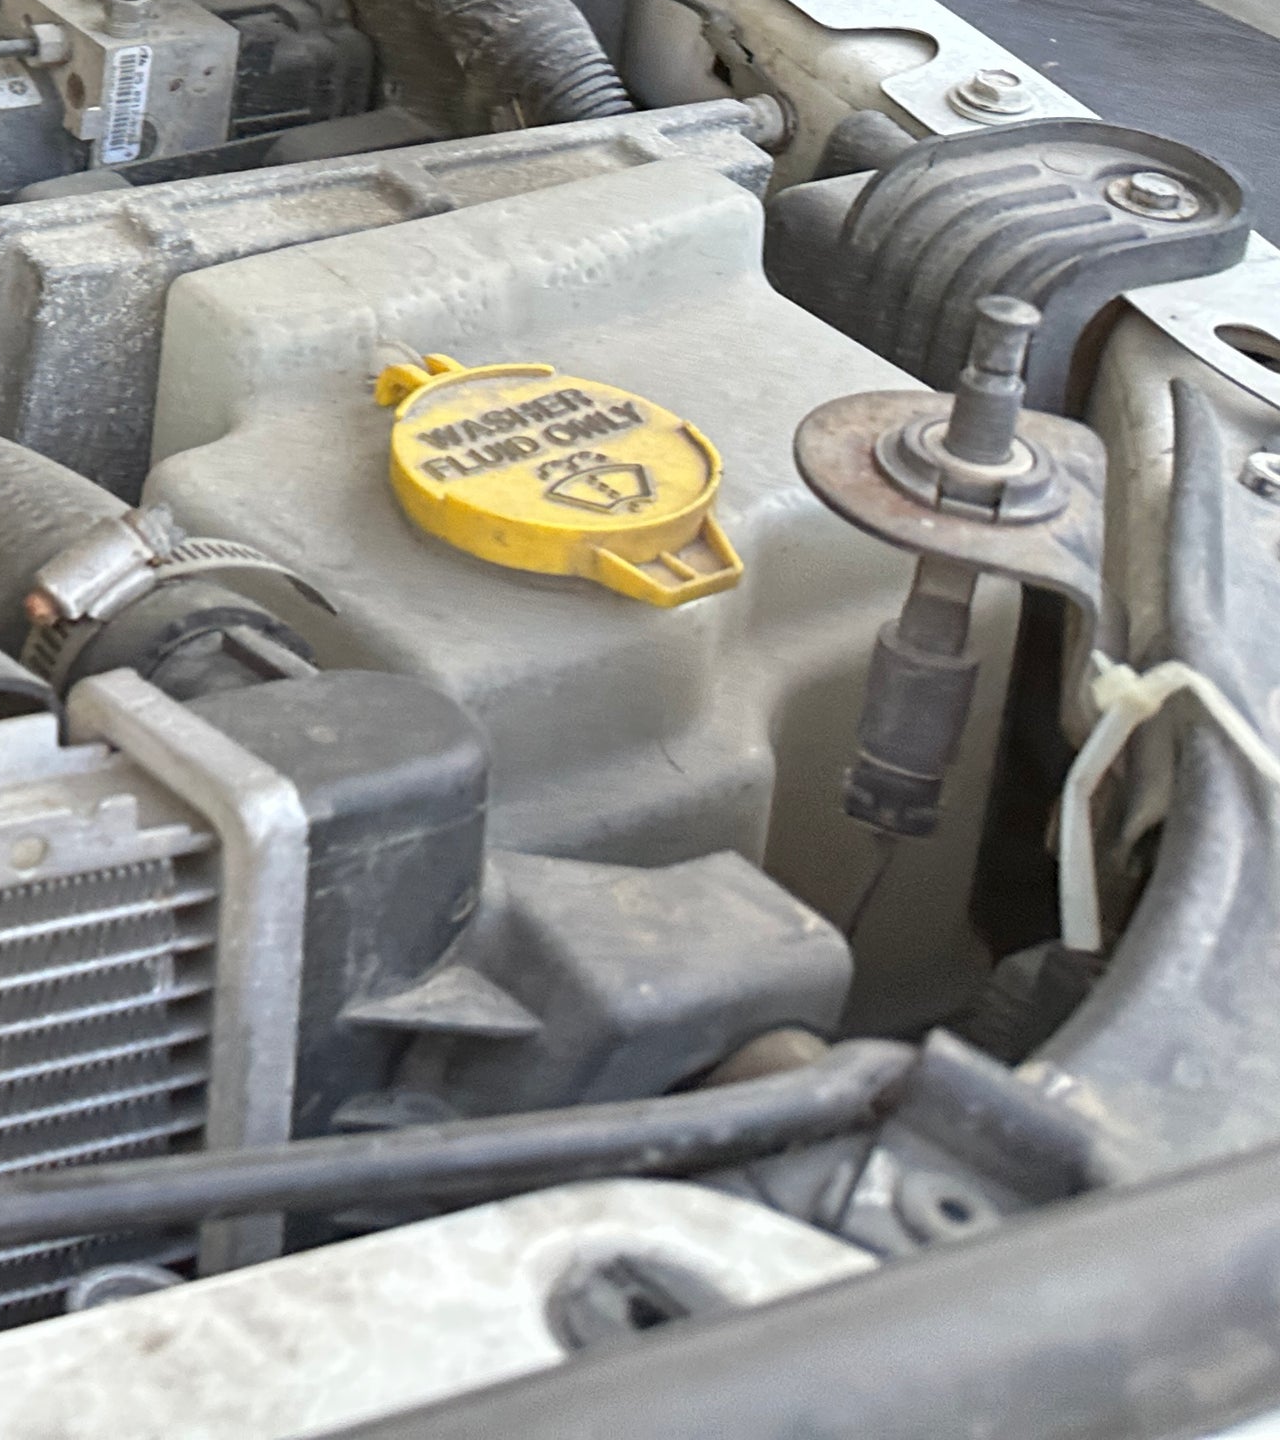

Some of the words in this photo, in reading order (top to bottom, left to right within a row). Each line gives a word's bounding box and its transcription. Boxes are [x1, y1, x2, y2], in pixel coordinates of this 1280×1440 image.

[418, 388, 594, 449] WASHER
[421, 435, 540, 481] FLUID
[543, 401, 644, 446] ONLY
